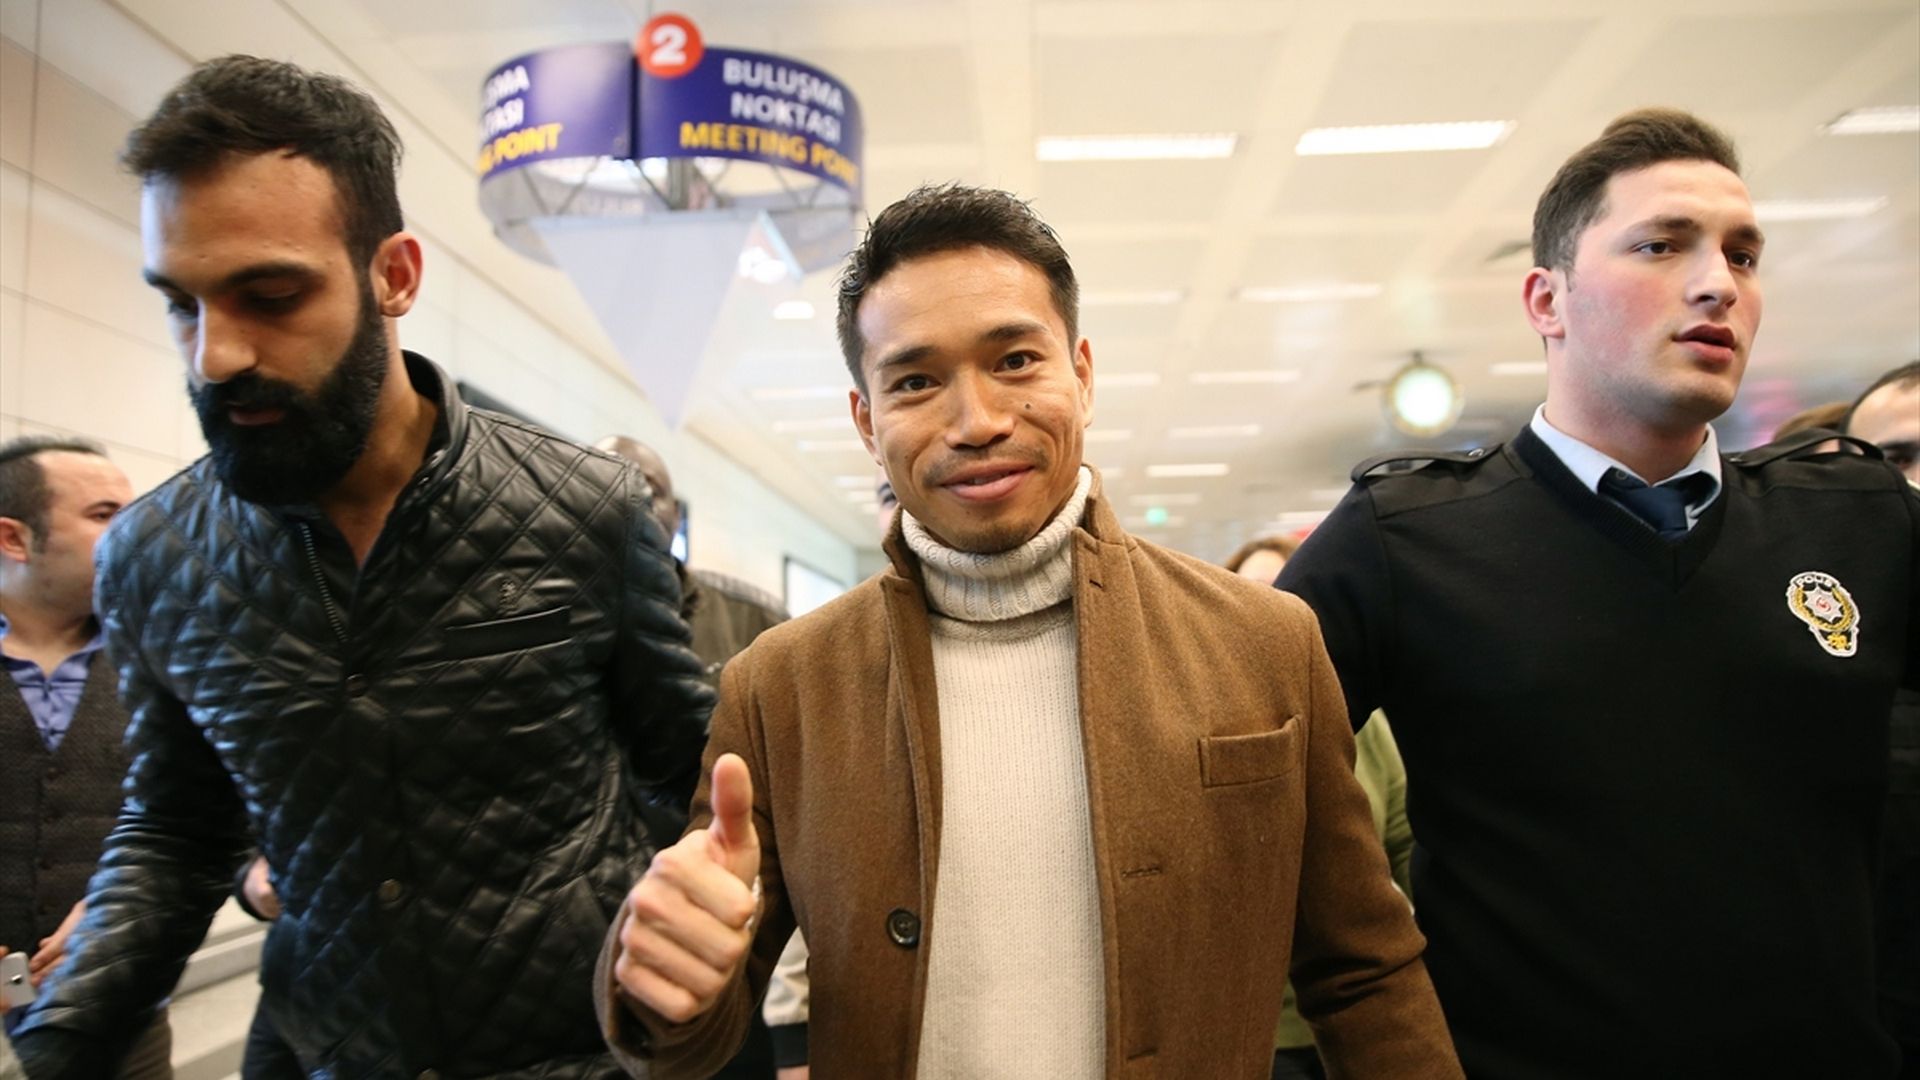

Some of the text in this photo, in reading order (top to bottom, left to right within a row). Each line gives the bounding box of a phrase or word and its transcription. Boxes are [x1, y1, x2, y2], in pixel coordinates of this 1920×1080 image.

[650, 24, 688, 65] 2
[722, 57, 845, 116] BULUŞMA
[730, 91, 841, 145] NOKTASI
[494, 122, 563, 166] POINT
[680, 121, 808, 164] MEETING
